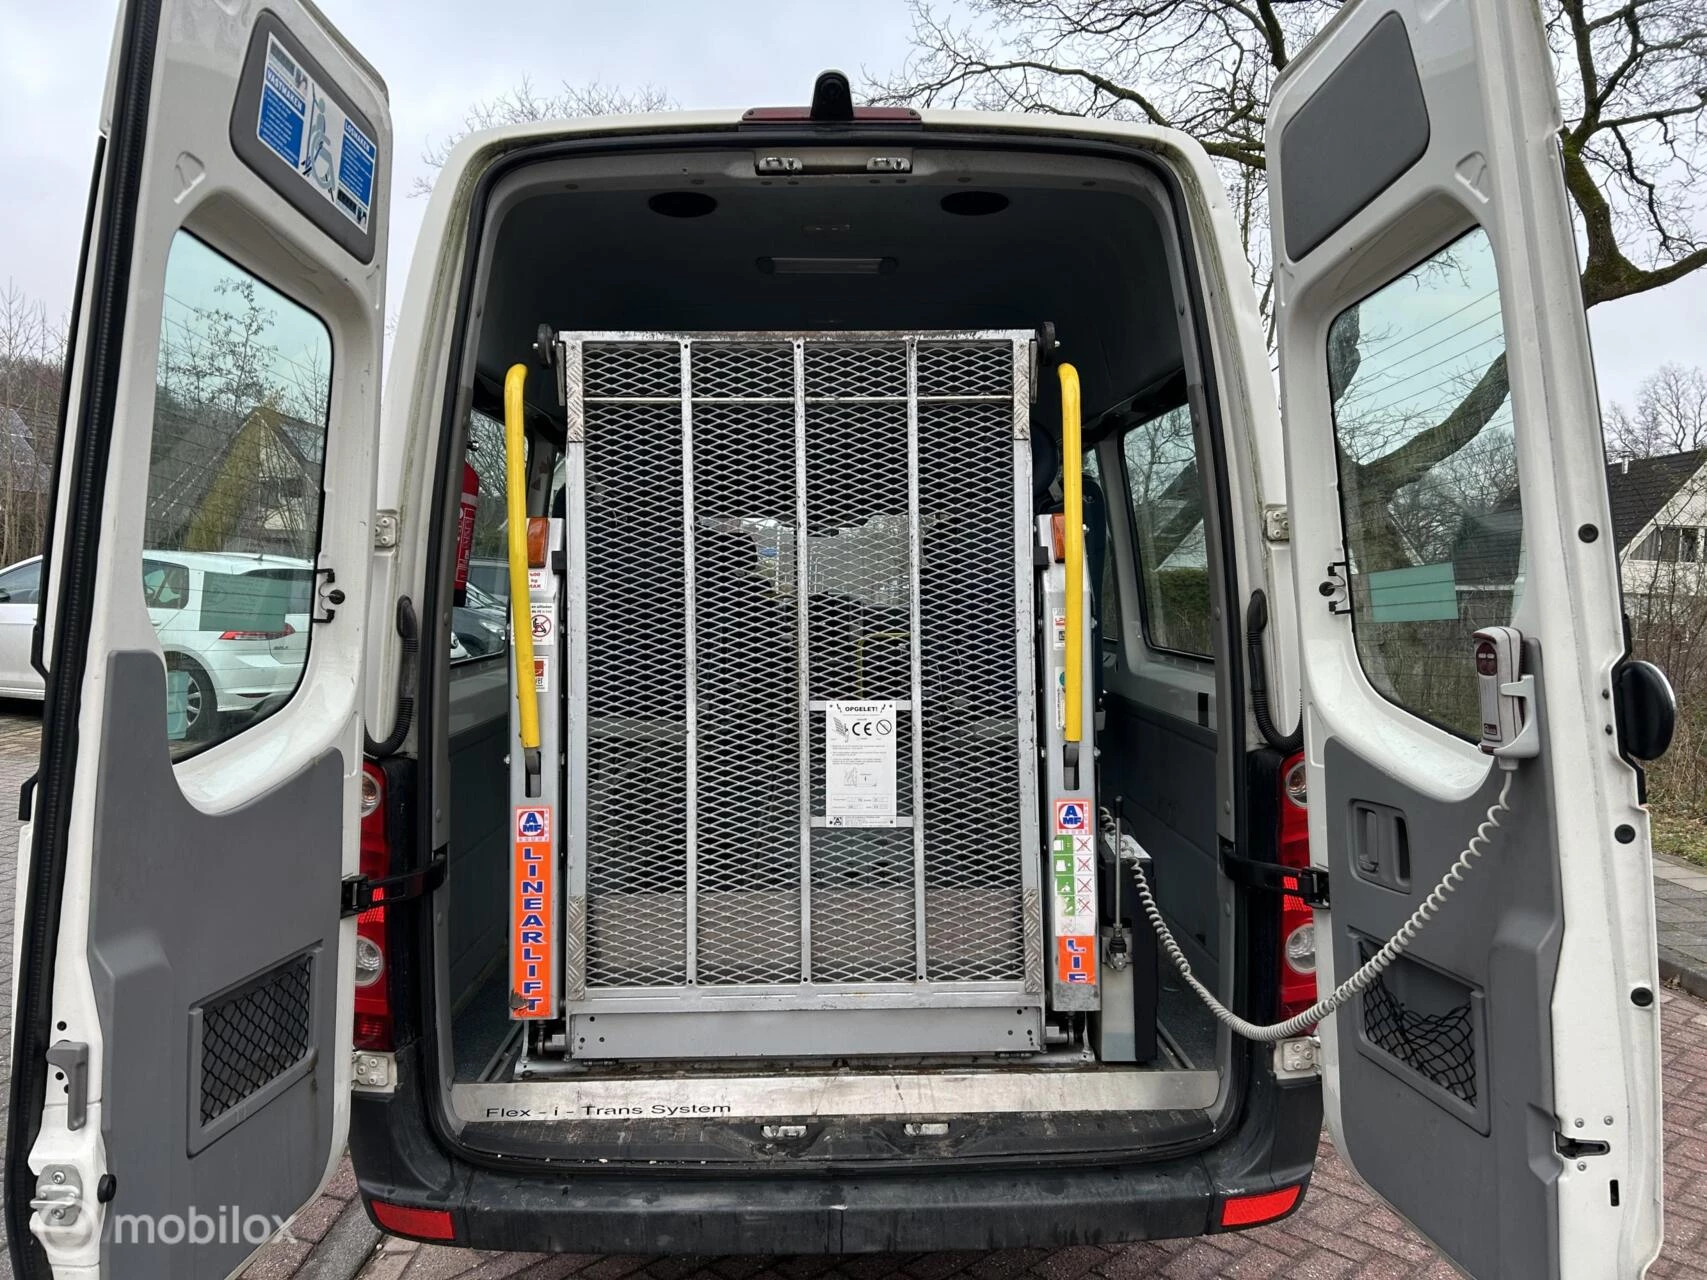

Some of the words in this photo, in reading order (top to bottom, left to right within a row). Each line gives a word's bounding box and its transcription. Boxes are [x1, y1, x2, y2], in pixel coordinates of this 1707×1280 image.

[266, 70, 303, 111] VASTMAKEN
[345, 121, 370, 152] LOSMAKEN
[852, 722, 872, 736] CE
[521, 848, 544, 1011] LINEARLIFT
[486, 1106, 532, 1118] Flex
[581, 1103, 643, 1116] Trans
[650, 1103, 732, 1116] System
